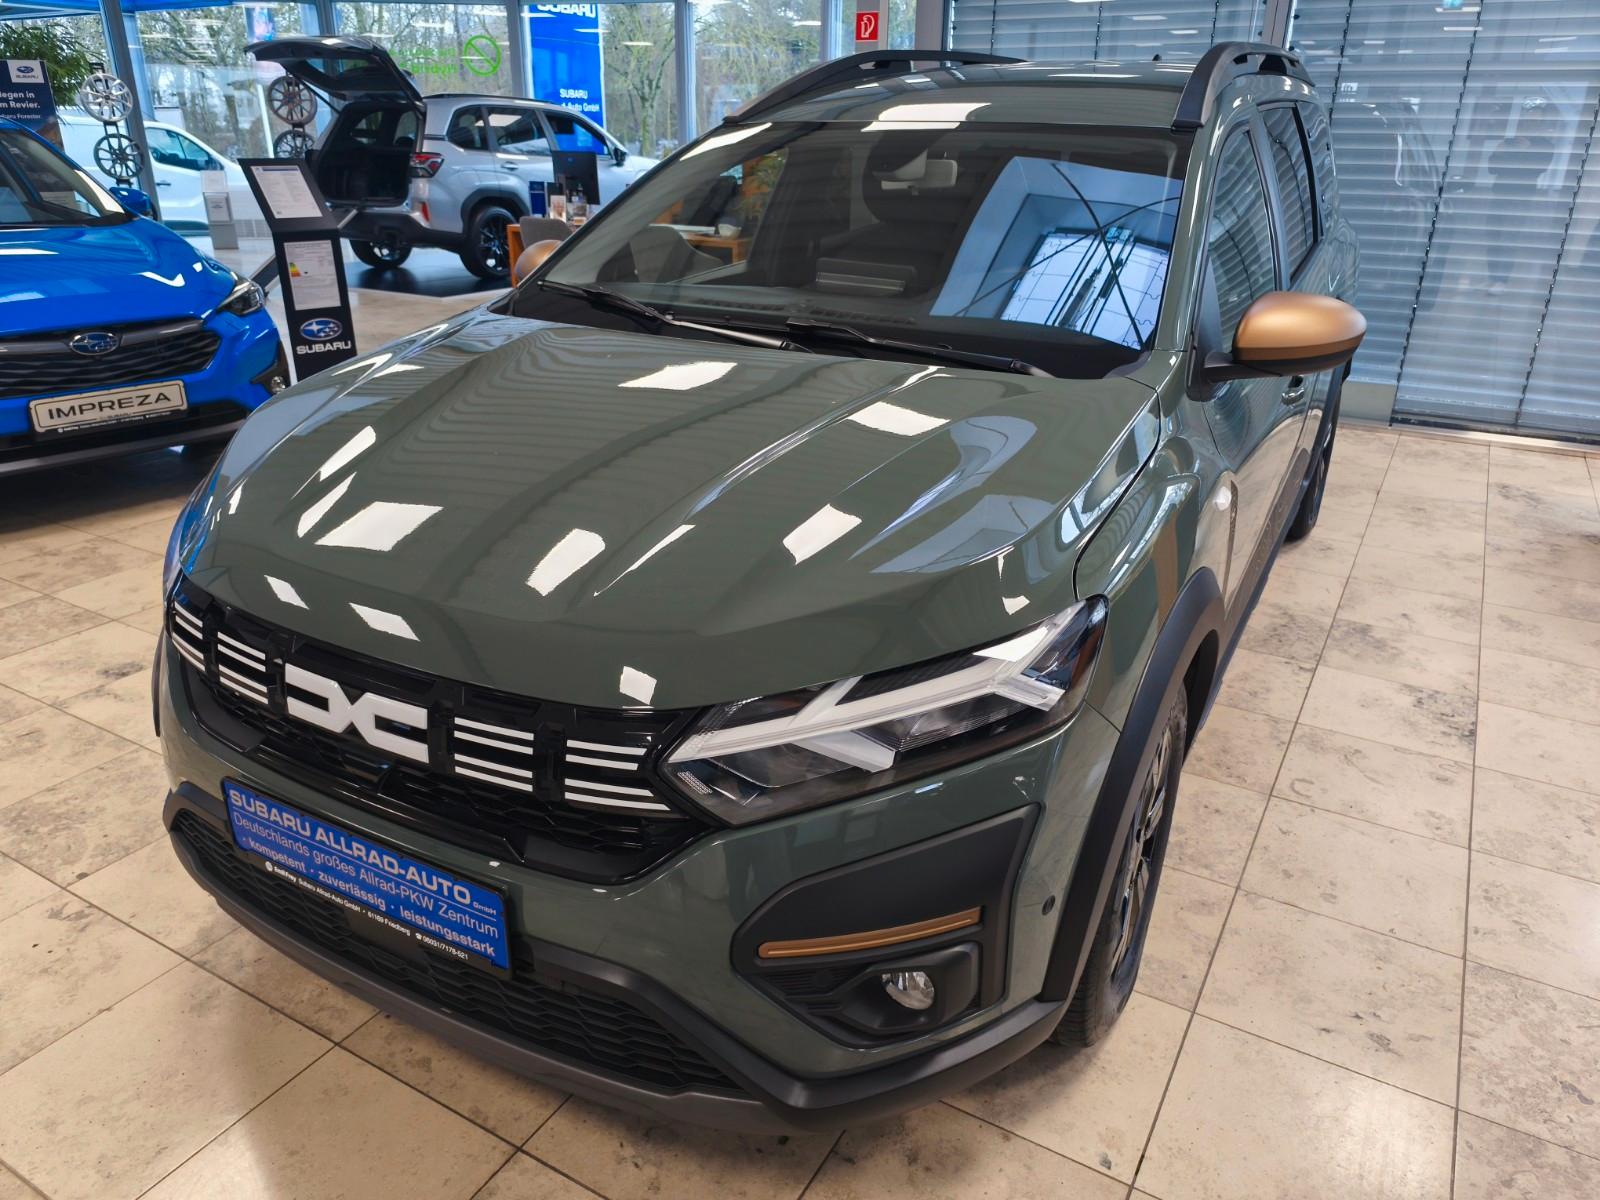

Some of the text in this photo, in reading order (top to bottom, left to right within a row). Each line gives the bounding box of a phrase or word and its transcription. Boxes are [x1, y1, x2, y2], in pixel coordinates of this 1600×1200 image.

[559, 88, 588, 99] SUBARU
[296, 340, 352, 355] SUBARU
[48, 392, 171, 420] IMPREZA
[229, 789, 497, 916] SUBARU ALLRAD-AUTO GmbH
[233, 811, 499, 939] Deutschlands großes Allrad-PKW Zentrum
[248, 836, 496, 957] kompetent zuverlässig leistungsstark
